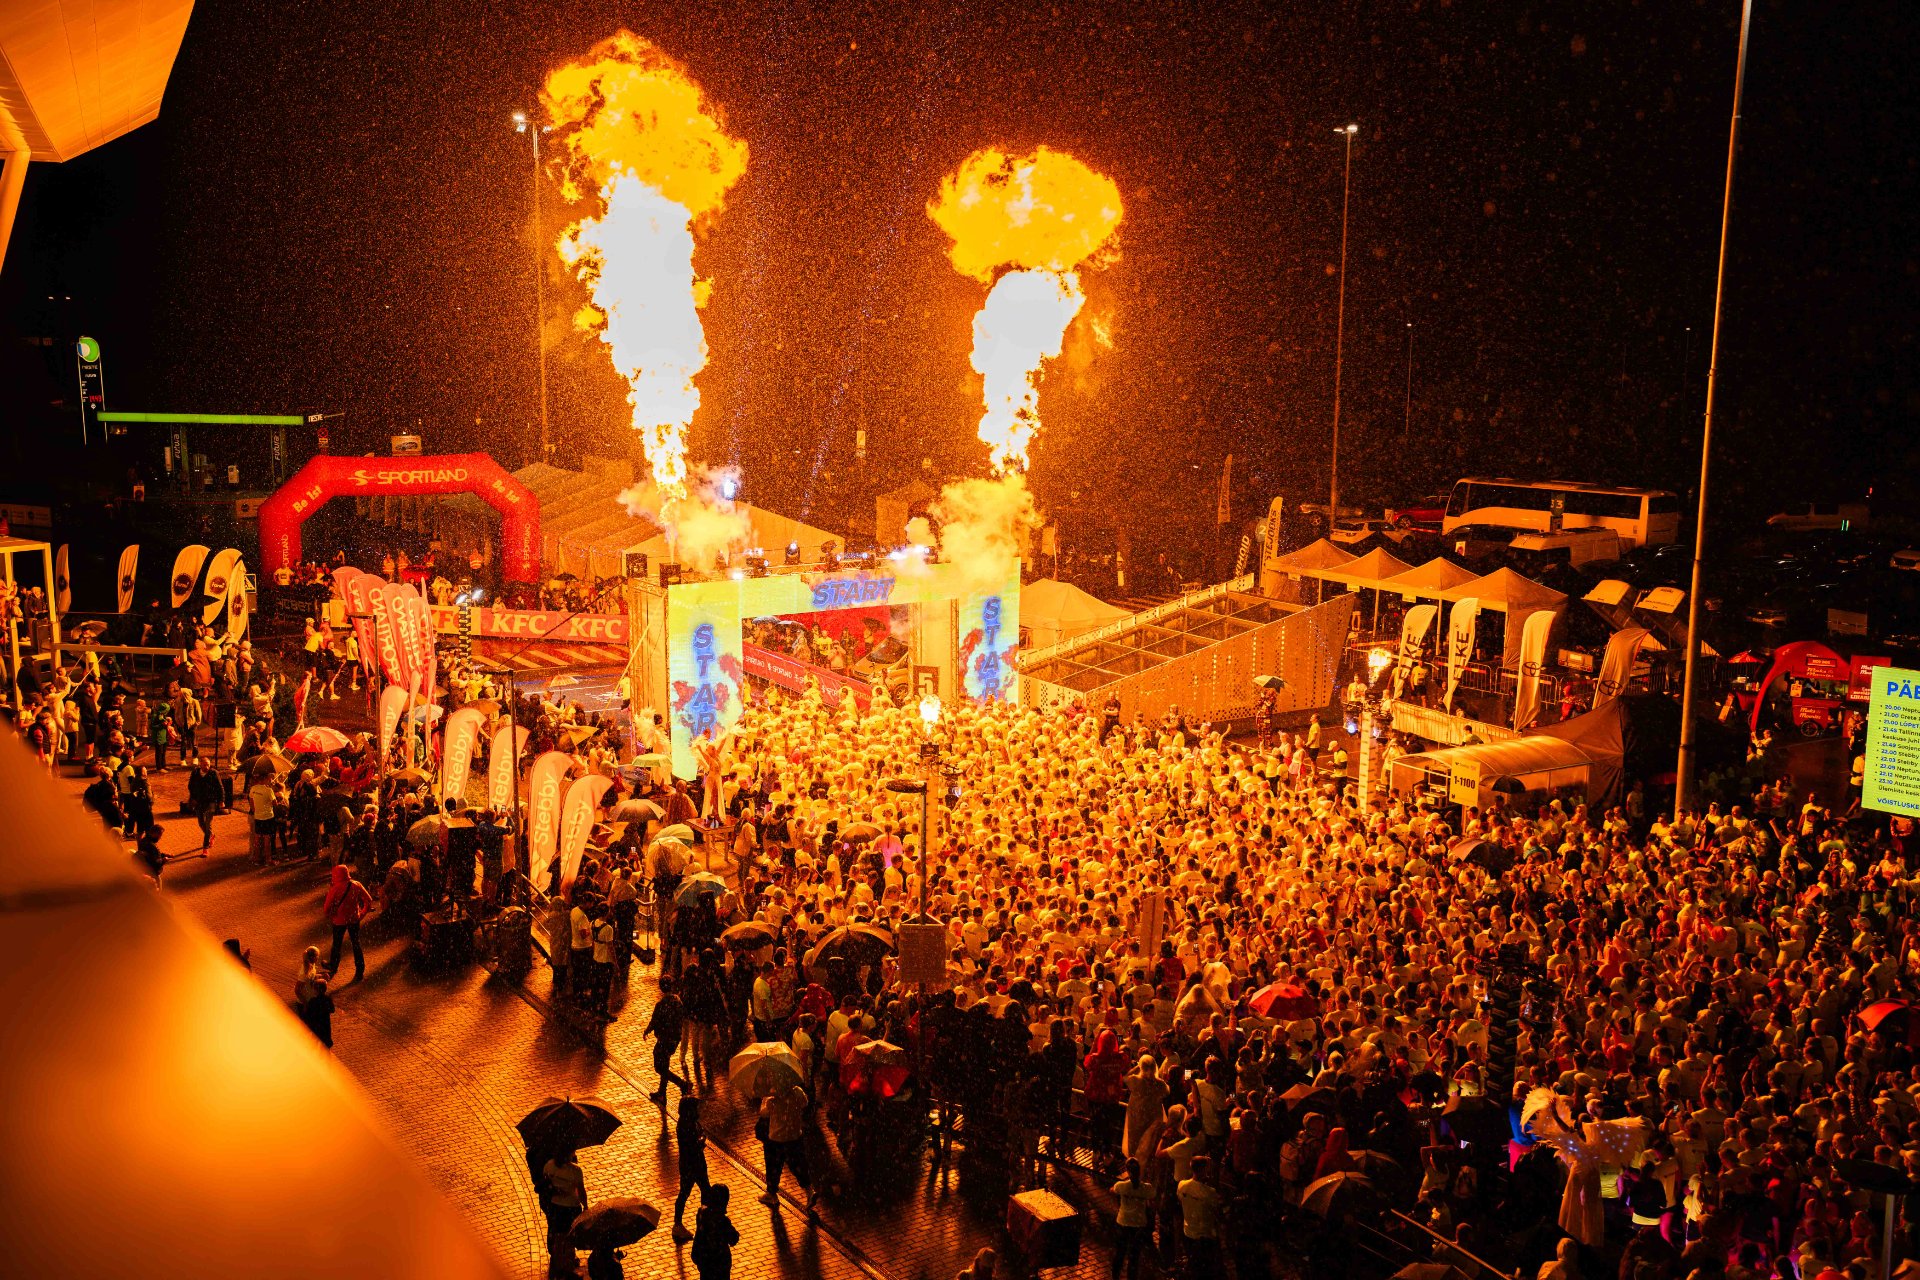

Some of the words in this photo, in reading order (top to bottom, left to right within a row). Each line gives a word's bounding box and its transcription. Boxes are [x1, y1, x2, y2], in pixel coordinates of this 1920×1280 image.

[377, 468, 468, 486] SPORTLAND
[292, 498, 308, 513] Be
[306, 485, 323, 501] 1st
[492, 479, 507, 492] Be
[505, 489, 520, 504] 1st
[1258, 525, 1267, 535] 2
[812, 578, 895, 606] START
[490, 614, 548, 635] KFC
[569, 618, 622, 639] KFC
[918, 672, 934, 697] 5
[446, 727, 472, 795] Stebby
[1897, 759, 1919, 767] Stebby
[1898, 752, 1919, 760] Stebby
[492, 748, 513, 805] tebby
[1454, 775, 1476, 790] 1-1100
[534, 772, 559, 846] Stebby
